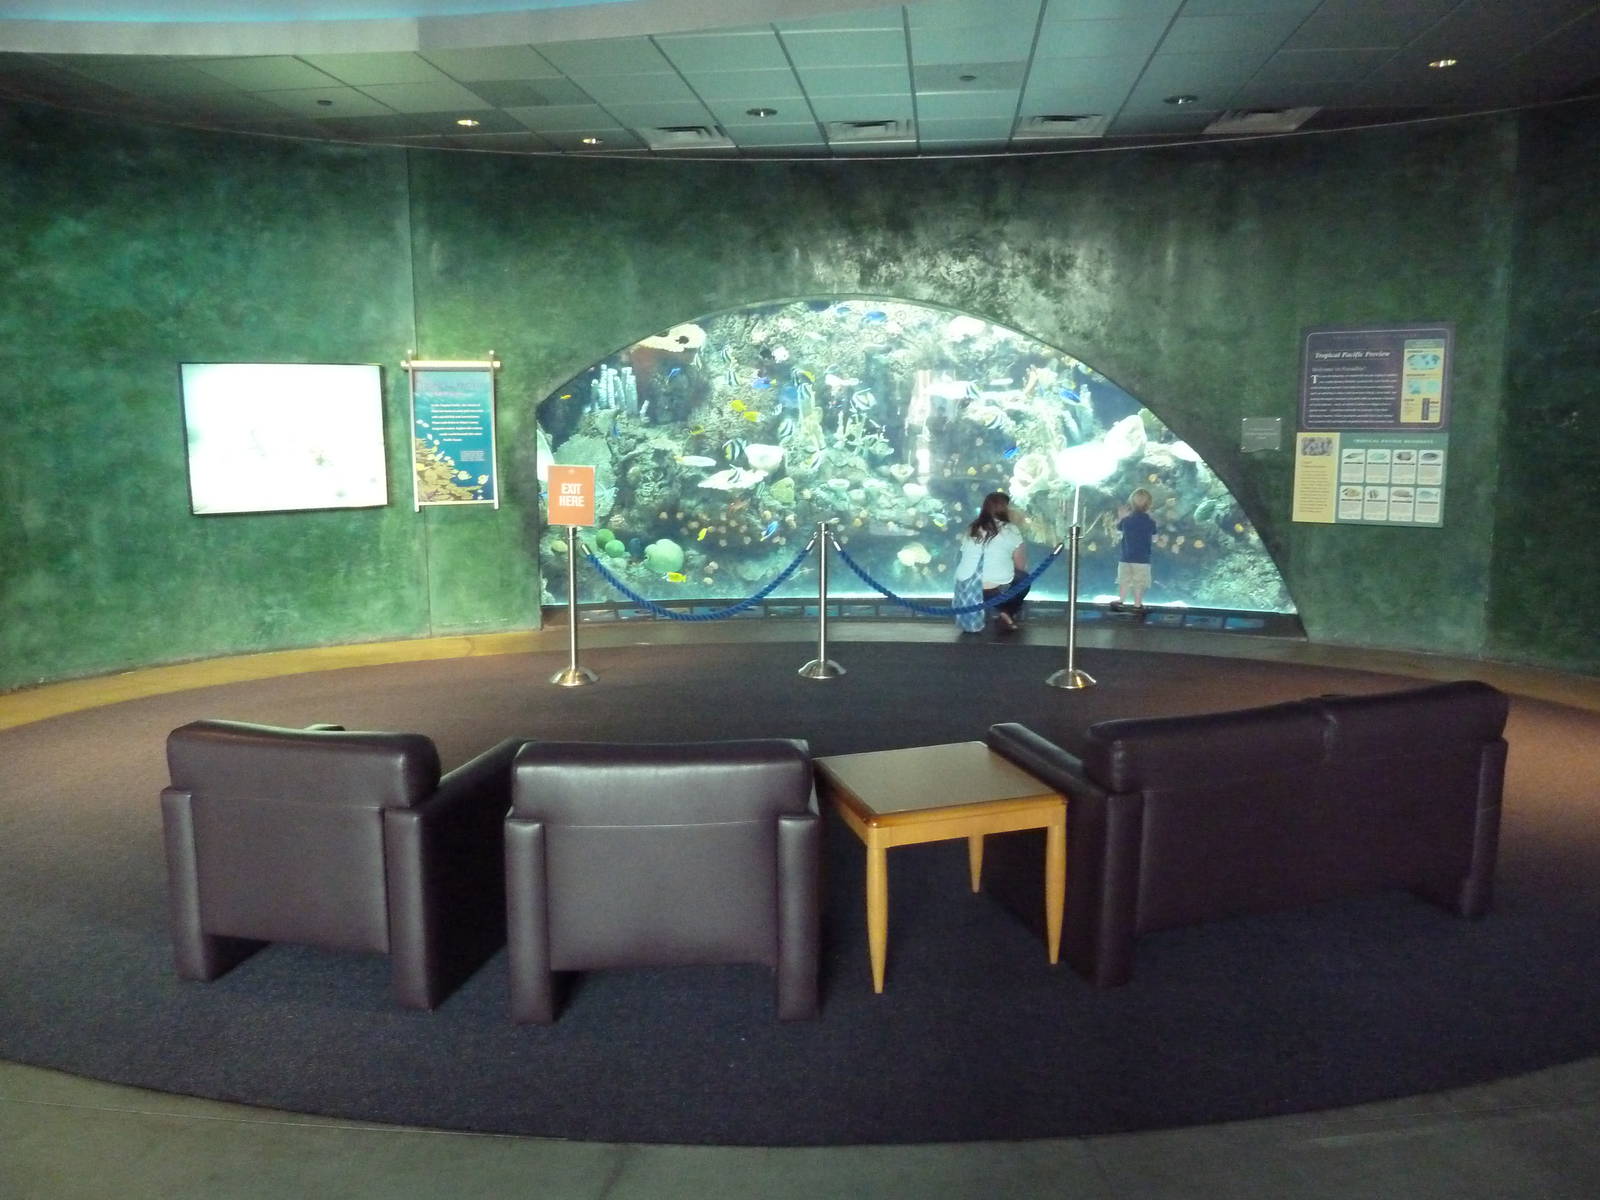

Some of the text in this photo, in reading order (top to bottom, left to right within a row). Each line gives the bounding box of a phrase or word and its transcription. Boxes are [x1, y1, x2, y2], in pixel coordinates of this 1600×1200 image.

[1314, 350, 1391, 360] Tropical Pacific Preview
[561, 483, 583, 495] EXIT
[559, 495, 585, 507] HERE
